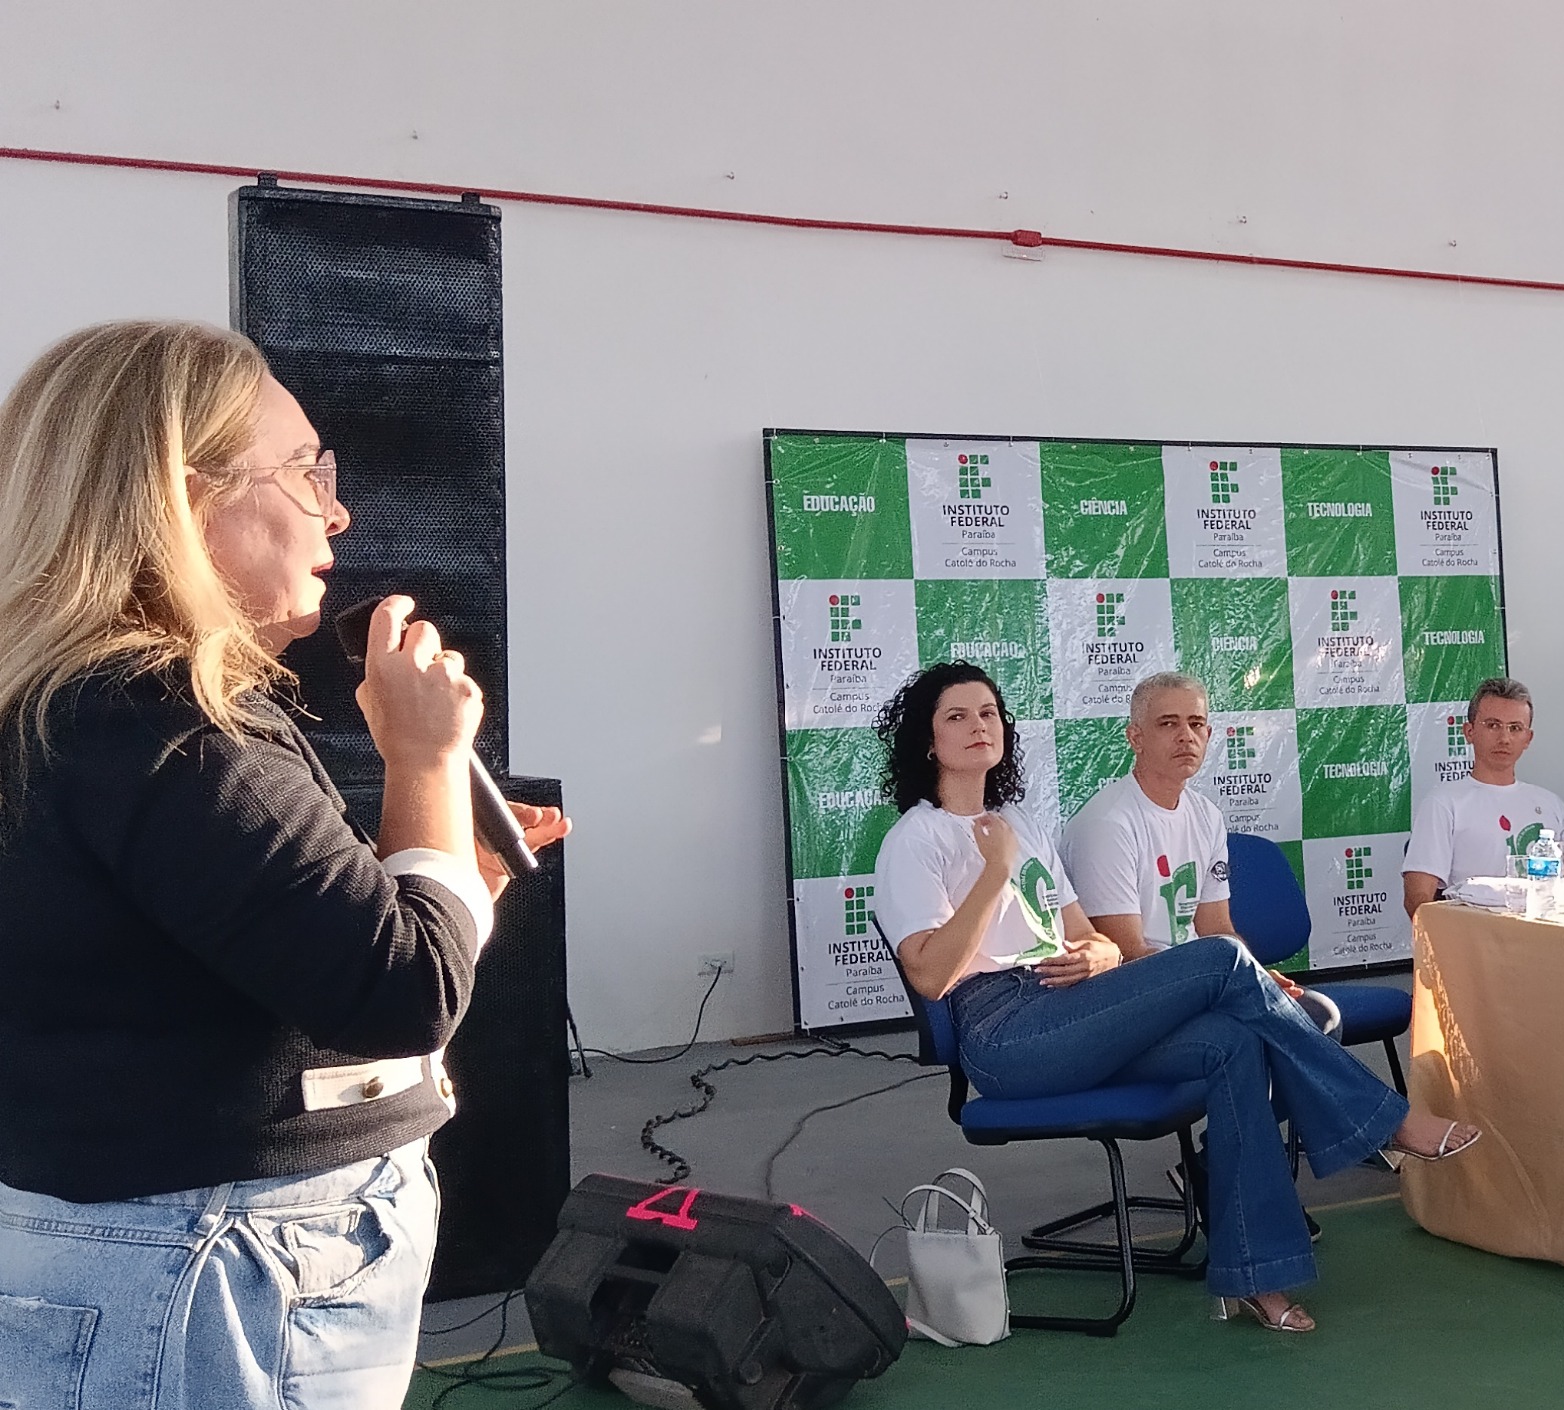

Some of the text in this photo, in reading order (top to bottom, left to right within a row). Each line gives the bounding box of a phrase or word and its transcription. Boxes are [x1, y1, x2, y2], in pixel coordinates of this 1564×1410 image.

[803, 492, 876, 516] EDUCAÇÃO
[1080, 497, 1128, 516] CIÊNCIA
[1307, 502, 1373, 517] TECNOLOGIA
[942, 504, 1010, 516] INSTITUTO
[1196, 508, 1257, 519] INSTITUTO
[1420, 510, 1473, 521] INSTITUTO
[950, 516, 1005, 527] FEDERAL
[1203, 519, 1252, 530] FEDERAL
[1426, 521, 1469, 531] FEDERAL
[962, 529, 995, 539] Paraíba
[1213, 532, 1244, 541] Paraíba
[1435, 533, 1462, 541] Paraíba
[961, 547, 998, 558] Campus
[1213, 548, 1246, 558] Campus
[1435, 548, 1464, 558] Campus
[945, 558, 1017, 568] Catolé do Rocha
[1198, 559, 1263, 568] Catolé do Rocha
[1445, 558, 1455, 567] do
[1456, 557, 1478, 566] Rocha
[1317, 635, 1374, 647] INSTITUTO
[1423, 630, 1485, 645] TECNOLOGIA
[813, 647, 882, 659] INSTITUTO
[1081, 642, 1144, 654] INSTITUTO
[1088, 653, 1140, 665] FEDERAL
[820, 659, 877, 671] FEDERAL
[1098, 666, 1131, 676] Paraíba
[830, 674, 867, 683] Paraíba
[1333, 675, 1365, 685] Cmpus
[1098, 684, 1133, 694] Campus
[1345, 685, 1355, 694] do
[1357, 684, 1380, 693] Rocha
[829, 692, 870, 703] Campus
[1082, 694, 1110, 705] Catolé
[1111, 694, 1123, 704] do
[813, 703, 843, 714] Catolé
[845, 703, 858, 713] do
[1322, 761, 1389, 779] TECNOLOGIA
[1434, 760, 1475, 772] INSTITU
[1213, 773, 1272, 786] INSTITUTO
[1219, 783, 1267, 796] FEDERAL
[1229, 797, 1259, 807] Paraíba
[1229, 814, 1260, 824] Campus
[1240, 824, 1252, 833] do
[1253, 823, 1279, 832] Rocha
[1333, 892, 1387, 906] INSTITUTO
[1338, 903, 1383, 917] FEDERAL
[1347, 917, 1376, 927] Paraíba
[1347, 933, 1377, 944] Campus
[828, 938, 887, 955] INSTITUT
[1358, 944, 1369, 953] do
[1369, 941, 1392, 951] Rocha
[834, 950, 893, 966] FEDERAL
[846, 966, 882, 977] Paraíba
[845, 984, 885, 996] Campus
[828, 994, 905, 1010] Catolé do Rocha
